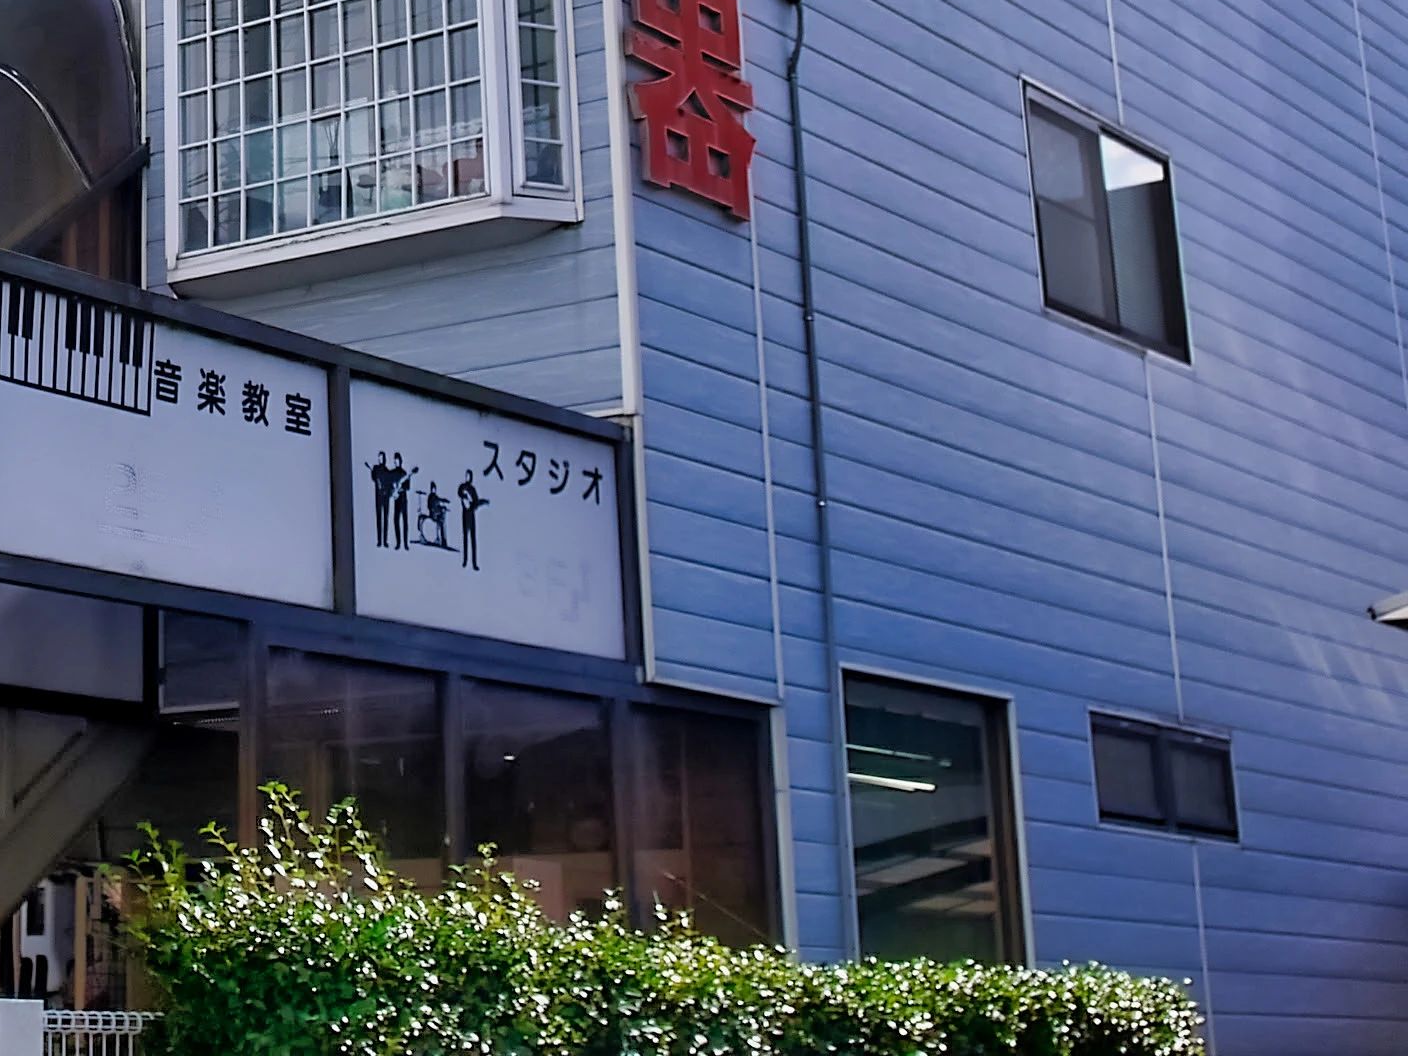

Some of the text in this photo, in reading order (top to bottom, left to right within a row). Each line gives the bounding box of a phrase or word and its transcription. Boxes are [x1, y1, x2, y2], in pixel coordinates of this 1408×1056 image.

[153, 359, 313, 437] 音楽教室
[482, 441, 604, 505] スタジオ
